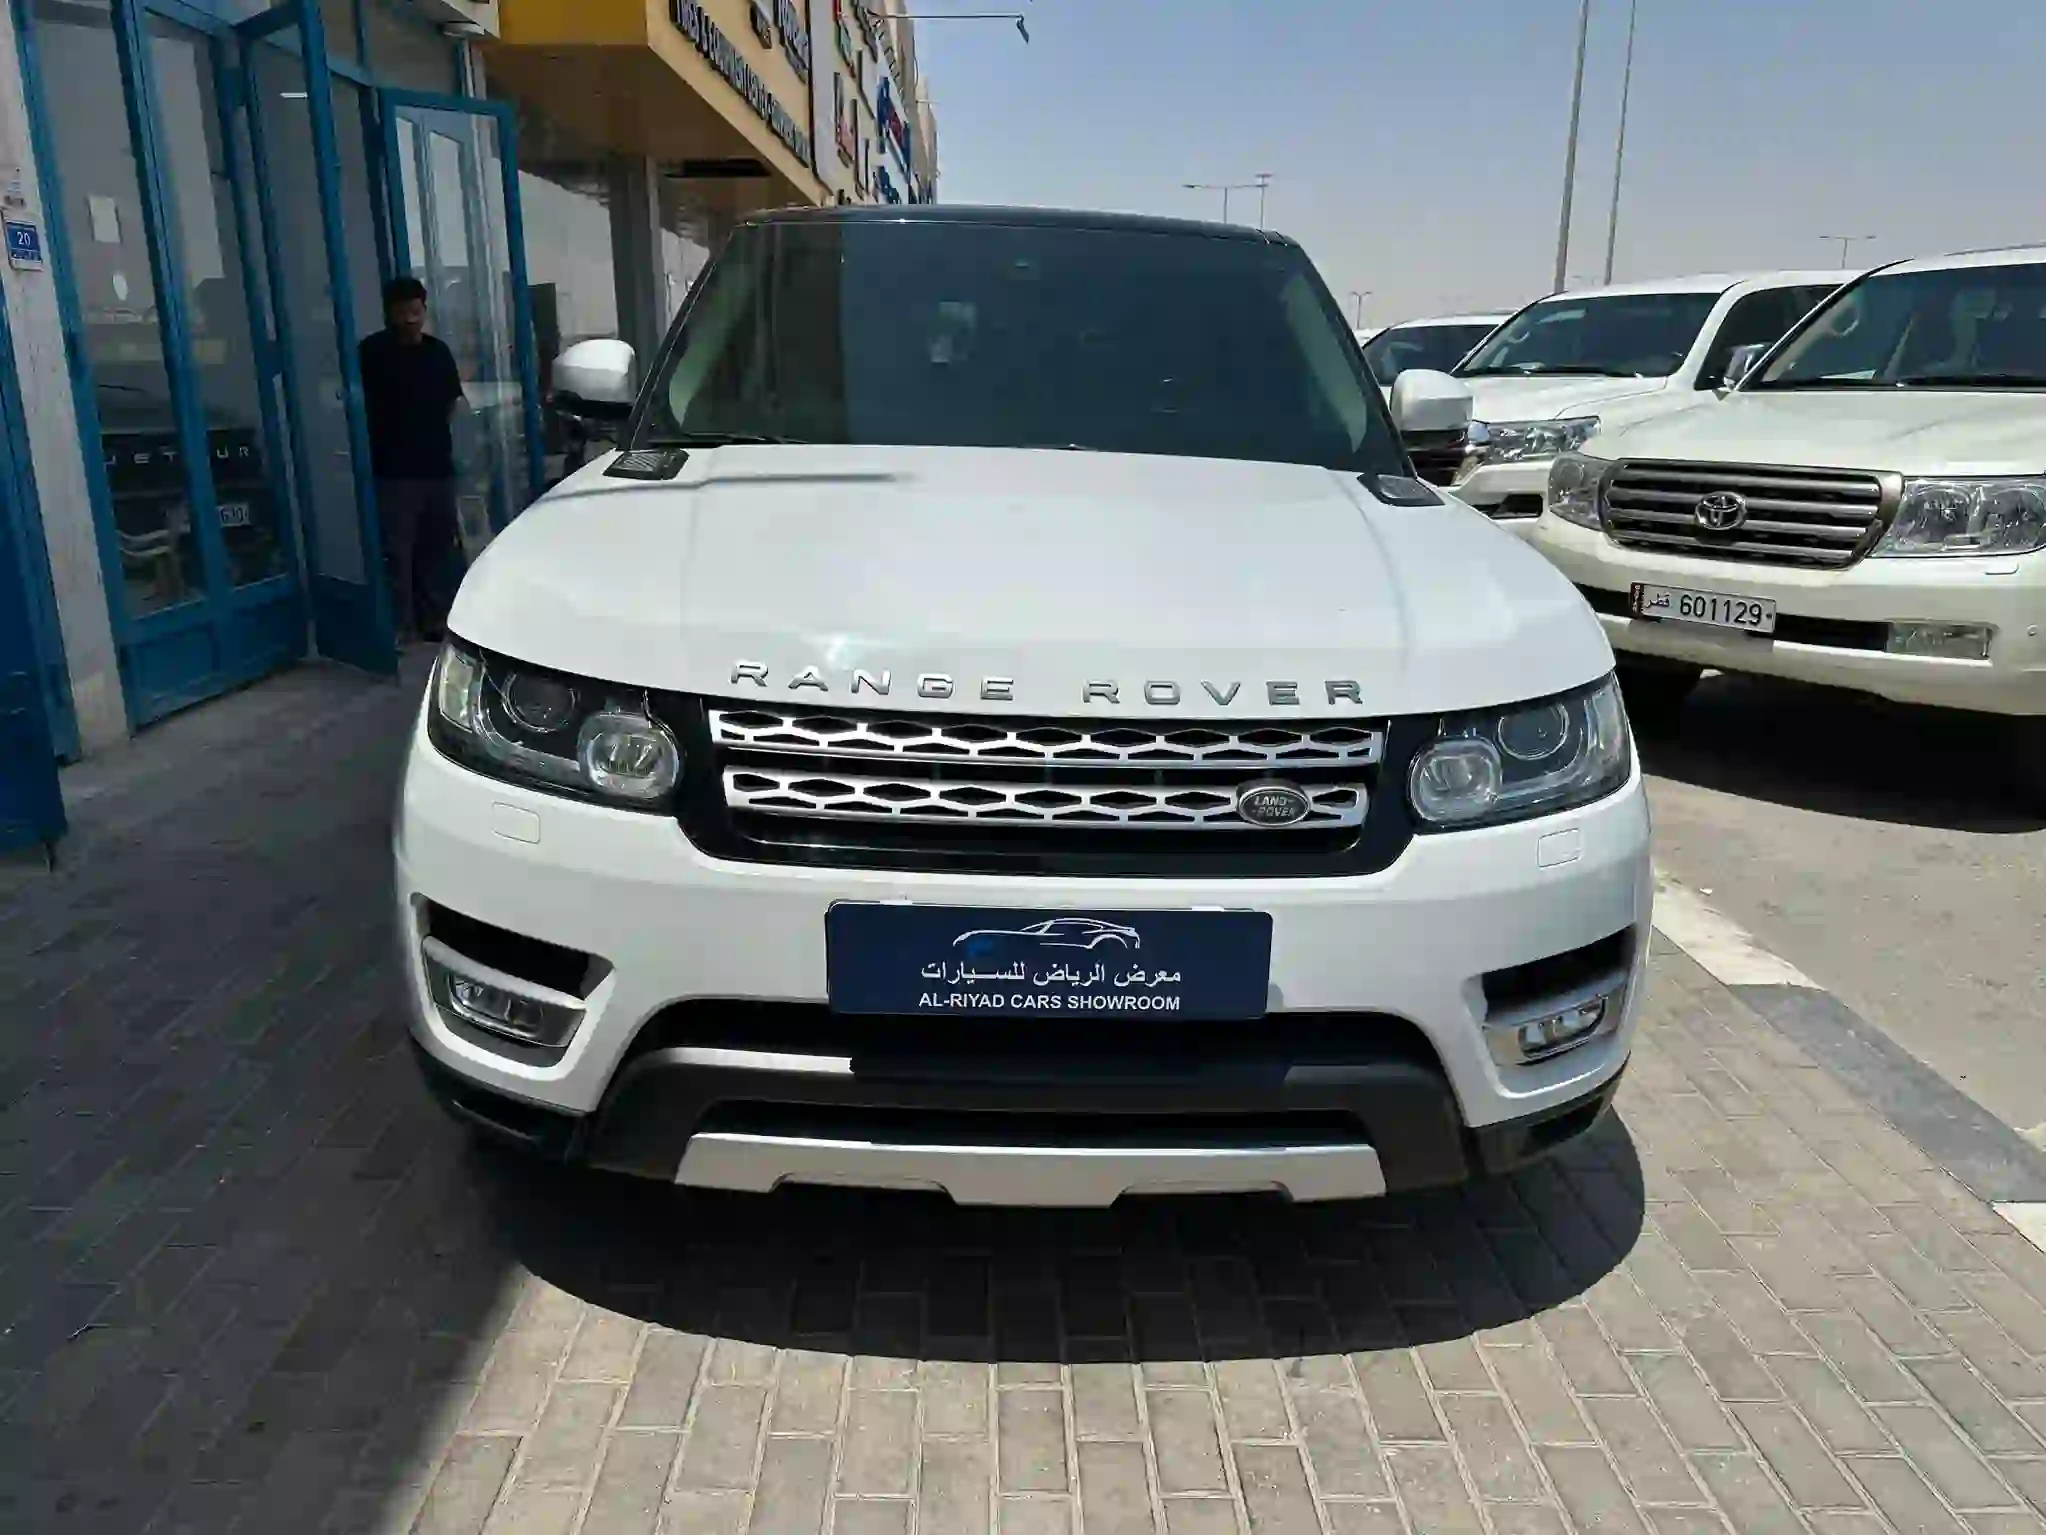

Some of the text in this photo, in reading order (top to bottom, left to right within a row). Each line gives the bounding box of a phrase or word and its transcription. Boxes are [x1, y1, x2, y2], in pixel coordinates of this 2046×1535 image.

[16, 231, 31, 246] 20
[103, 446, 249, 466] JETUR
[1680, 594, 1762, 626] 601129
[730, 659, 1364, 706] RANGE ROVER
[1253, 795, 1289, 806] LAND
[1256, 806, 1295, 817] ROVER
[1032, 962, 1105, 986] الرياض
[1113, 963, 1181, 987] معرض
[918, 992, 1181, 1010] AL-RIYAD CARS SHOWROOM
